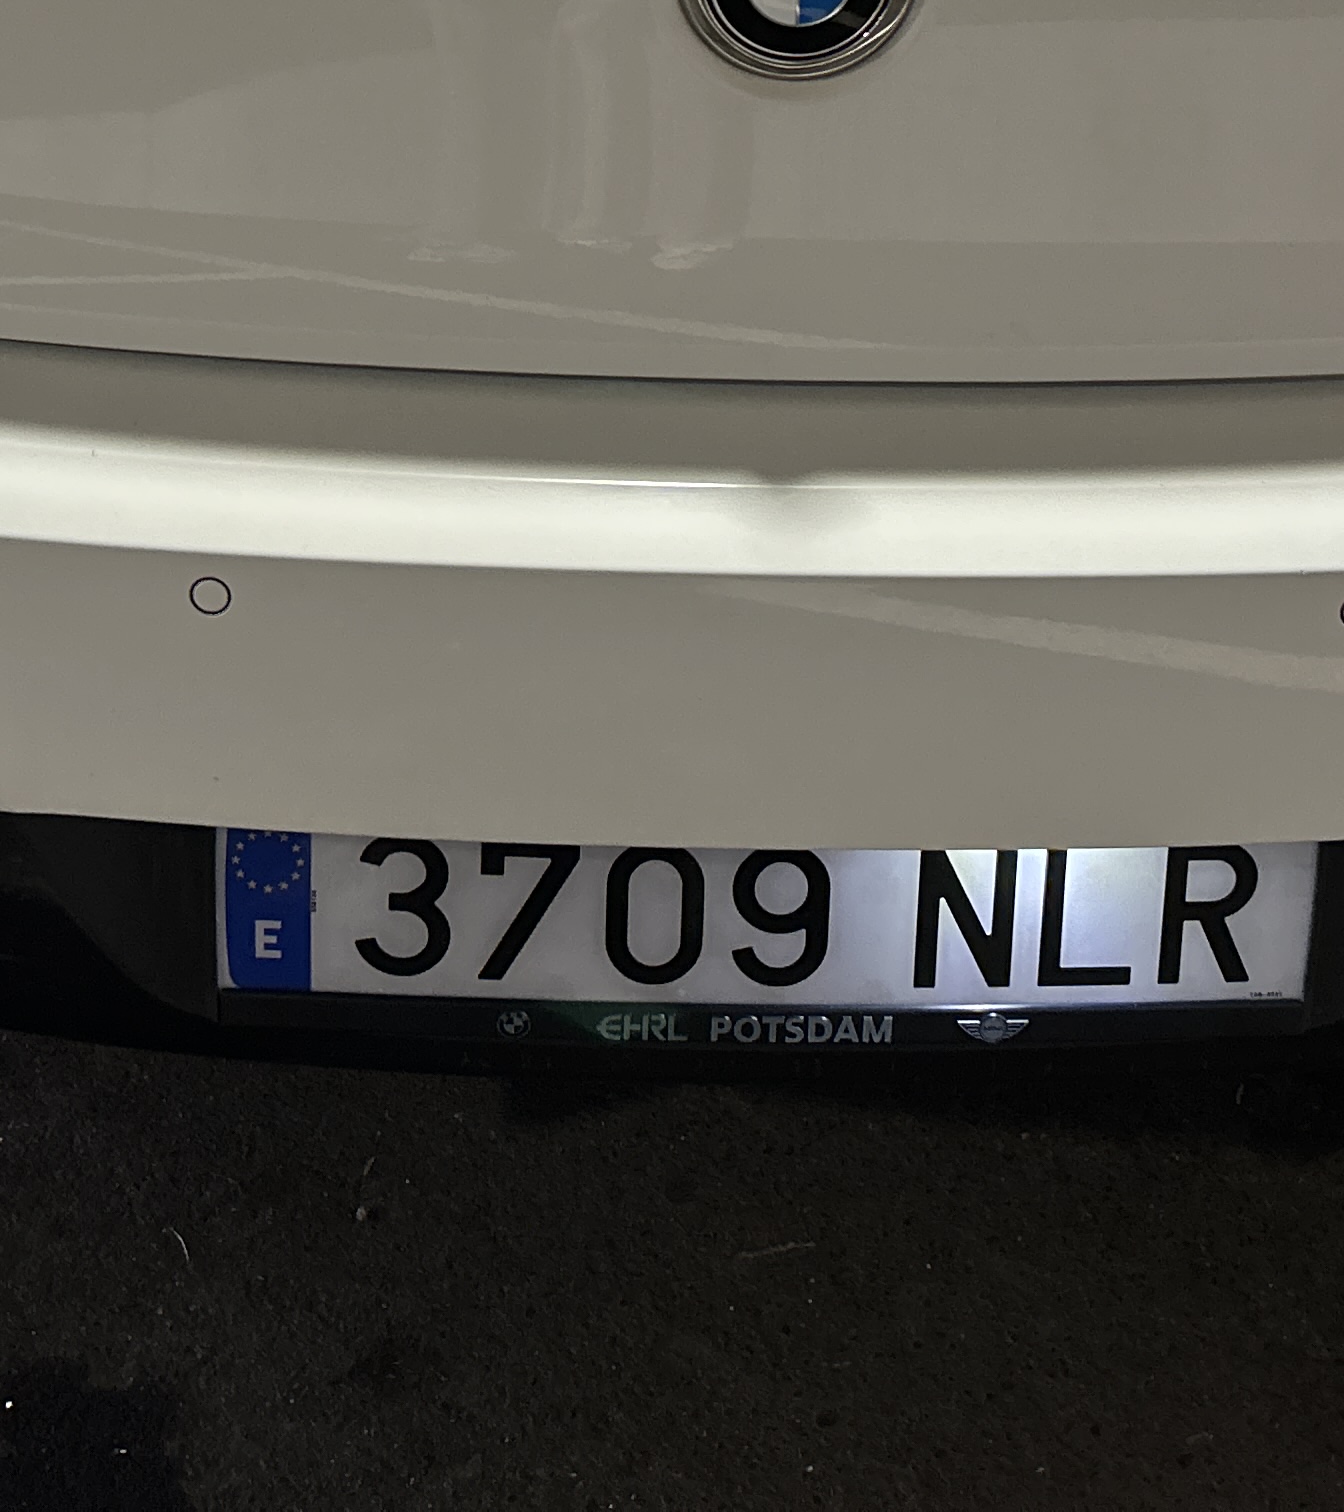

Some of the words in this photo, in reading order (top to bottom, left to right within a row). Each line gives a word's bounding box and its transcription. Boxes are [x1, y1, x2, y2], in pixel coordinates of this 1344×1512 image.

[354, 836, 832, 988] 3709
[912, 844, 1259, 989] NLR
[254, 919, 283, 960] E
[596, 1012, 689, 1042] EHRL
[709, 1015, 894, 1045] POTSDAM
